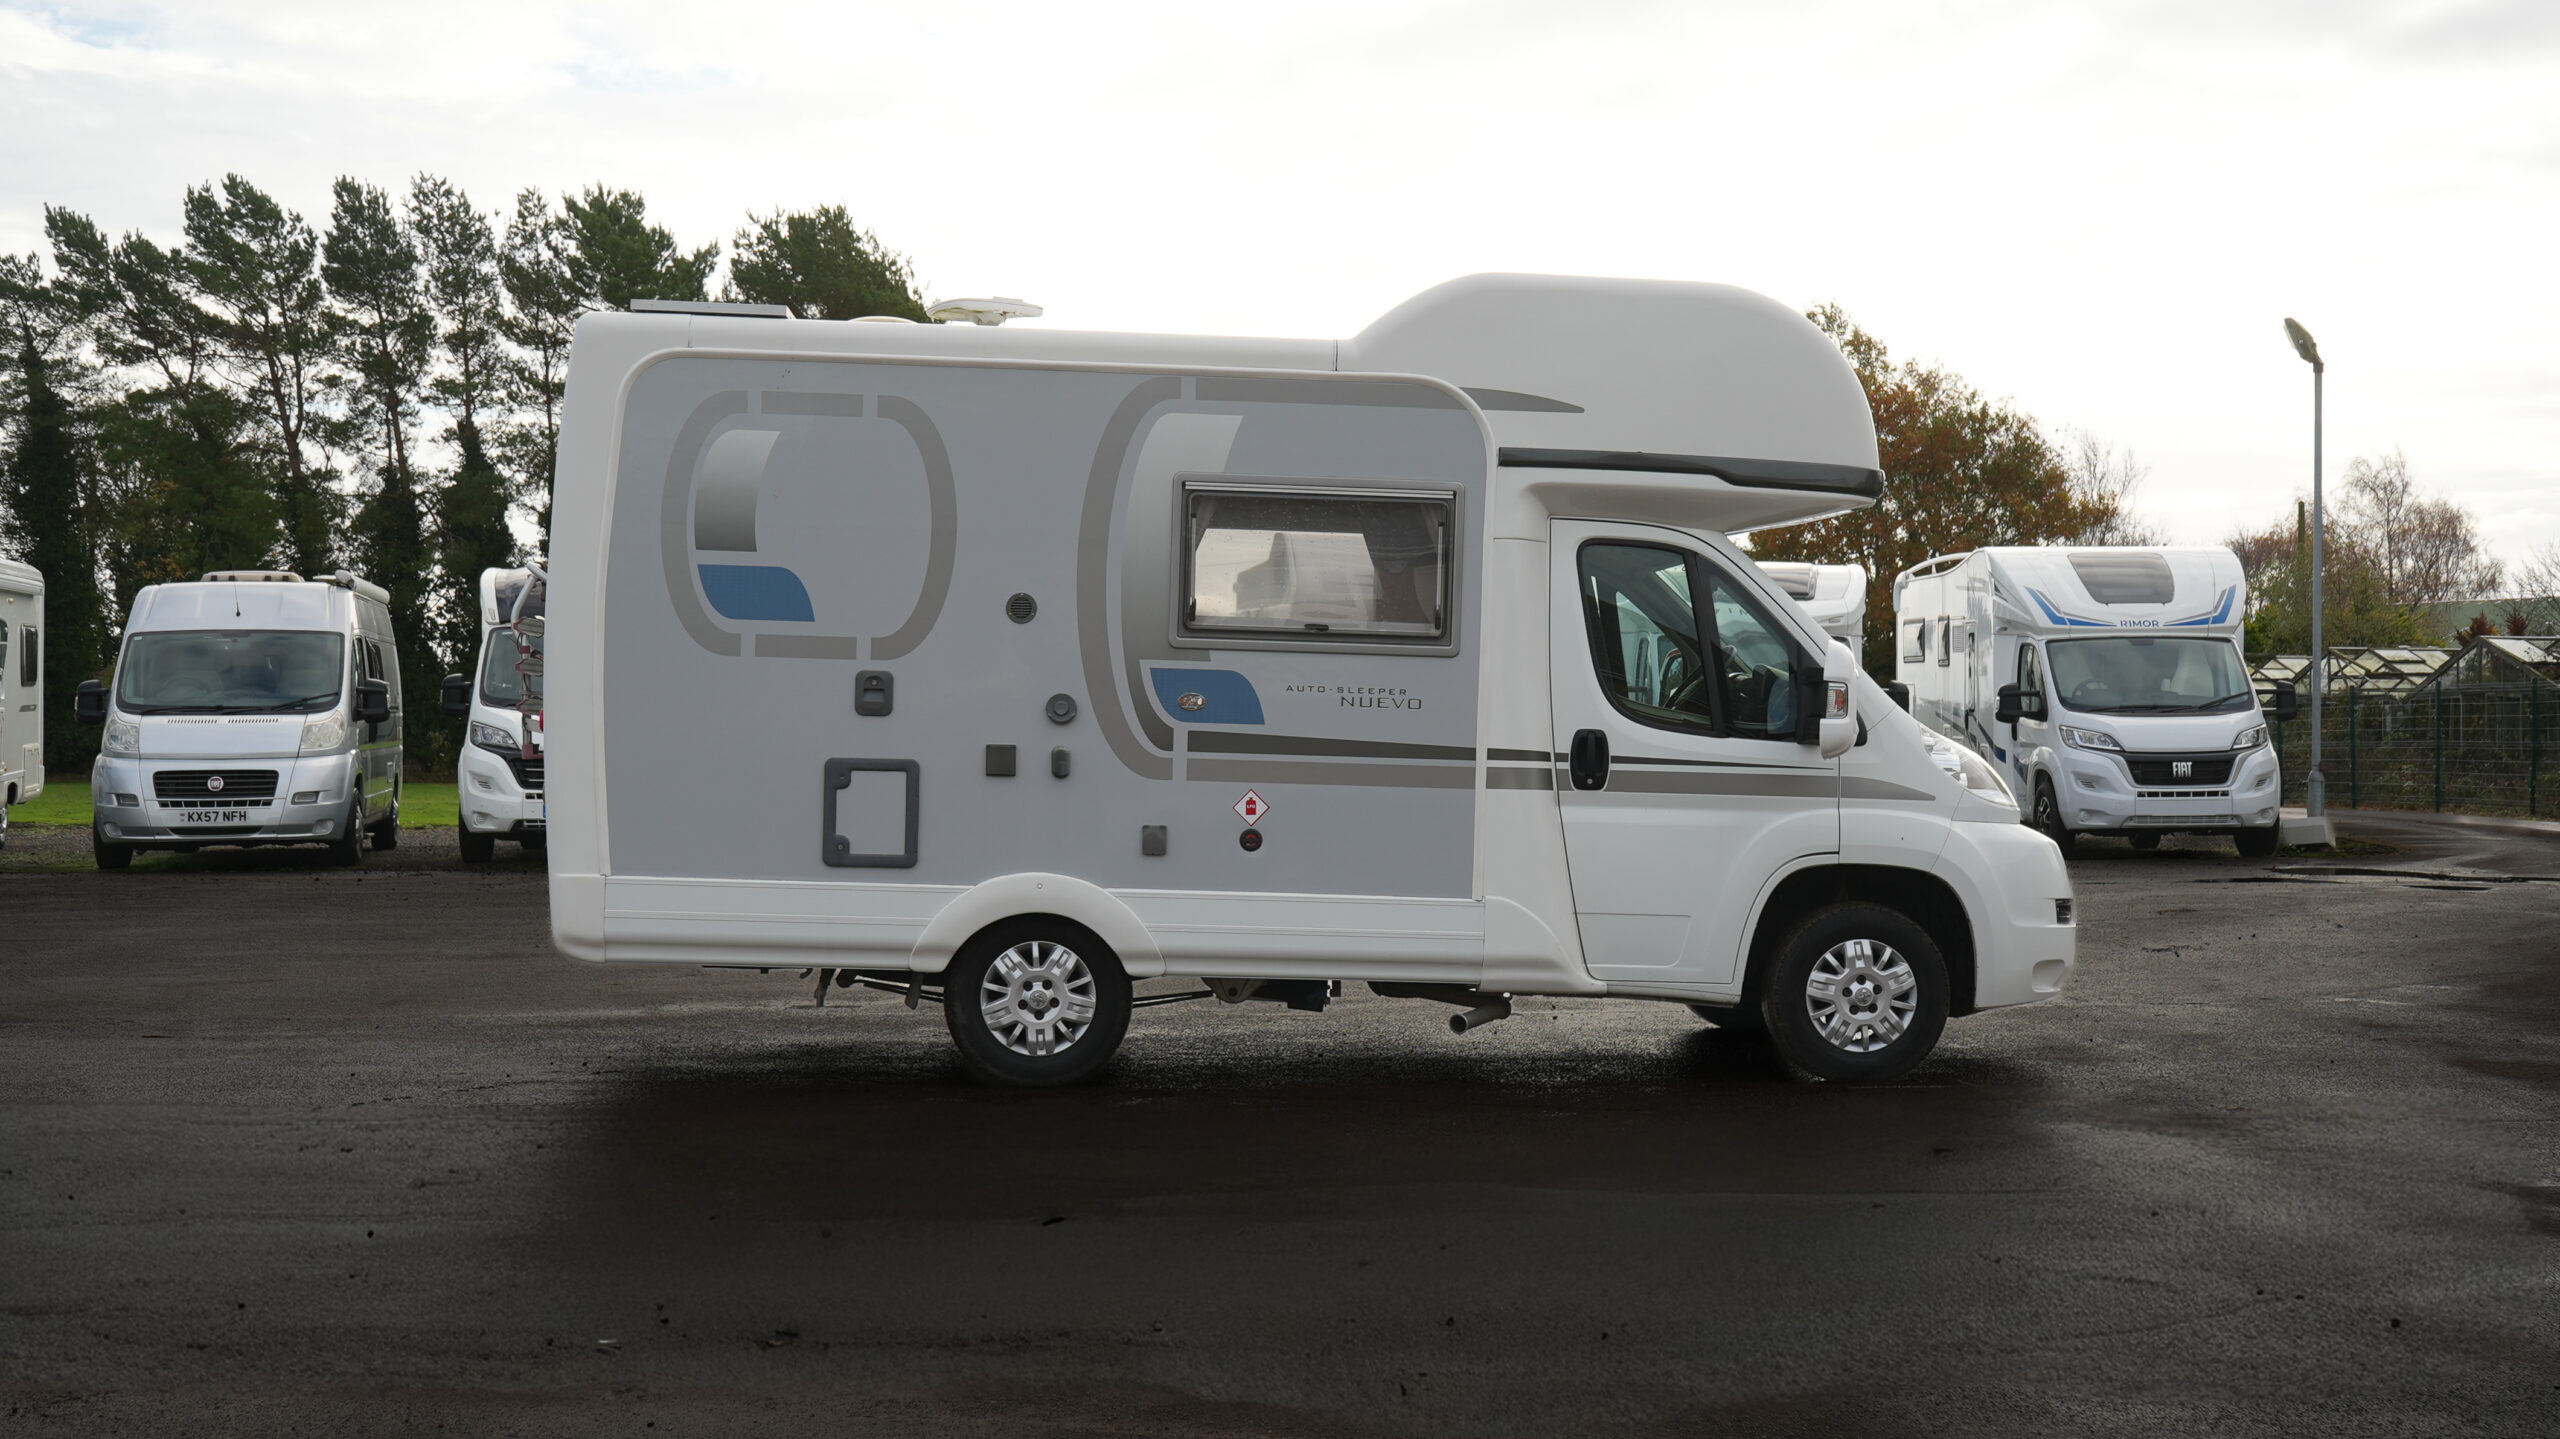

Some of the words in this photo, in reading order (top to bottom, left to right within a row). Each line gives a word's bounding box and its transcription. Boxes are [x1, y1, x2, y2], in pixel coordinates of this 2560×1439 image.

[1286, 685, 1407, 696] AUTO-SLEEPER
[1340, 696, 1422, 710] NUEVO
[2172, 761, 2192, 777] FIAT
[187, 811, 219, 822] KX57
[222, 810, 246, 821] NFH
